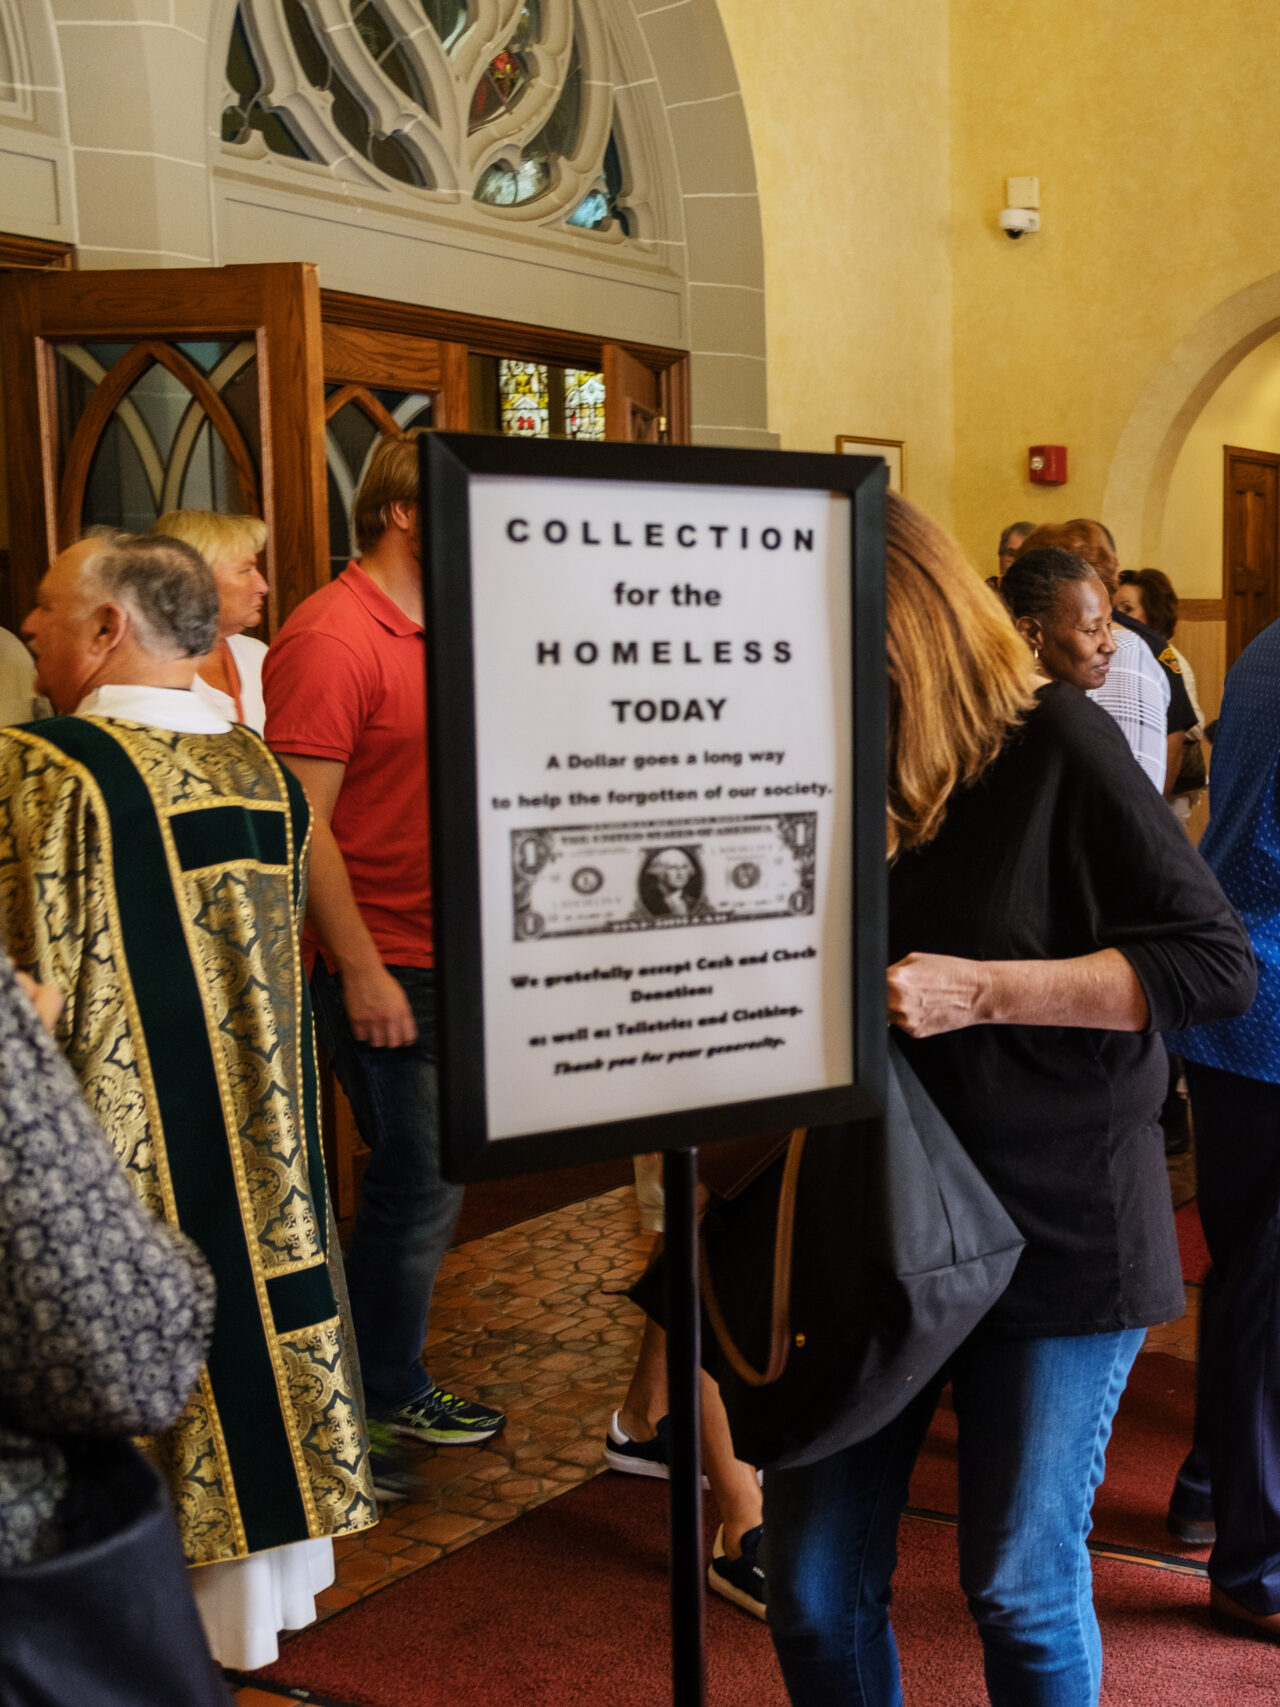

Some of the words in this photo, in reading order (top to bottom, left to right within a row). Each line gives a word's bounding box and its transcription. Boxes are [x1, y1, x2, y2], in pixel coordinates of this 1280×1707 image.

[505, 517, 814, 552] COLLECTION
[613, 581, 661, 607] for
[669, 582, 722, 608] the
[536, 640, 792, 666] HOMELESS
[610, 697, 727, 724] TODAY
[546, 755, 561, 770] A
[567, 753, 627, 770] Dollar
[633, 754, 680, 771] goes
[685, 753, 698, 765] a
[703, 750, 743, 767] long
[748, 751, 786, 765] way
[491, 797, 512, 810] to
[517, 793, 562, 810] help
[567, 791, 602, 806] the
[606, 788, 699, 807] forgotten
[703, 785, 723, 800] of
[727, 786, 758, 799] our
[763, 782, 833, 798] society.
[510, 974, 540, 990] We
[543, 965, 635, 989] gratefully
[695, 955, 735, 971] Cash
[737, 951, 769, 967] and
[771, 945, 818, 963] Check
[629, 984, 714, 1004] Donations
[528, 1035, 548, 1048] as
[551, 1027, 589, 1045] well
[592, 1027, 612, 1040] as
[615, 1017, 694, 1037] Toiletries
[696, 1011, 729, 1028] and
[731, 1005, 804, 1023] Clothing.
[553, 1057, 606, 1076] Thank
[606, 1055, 639, 1072] you
[640, 1051, 666, 1065] for
[665, 1047, 704, 1065] your
[705, 1036, 786, 1059] generosity.
